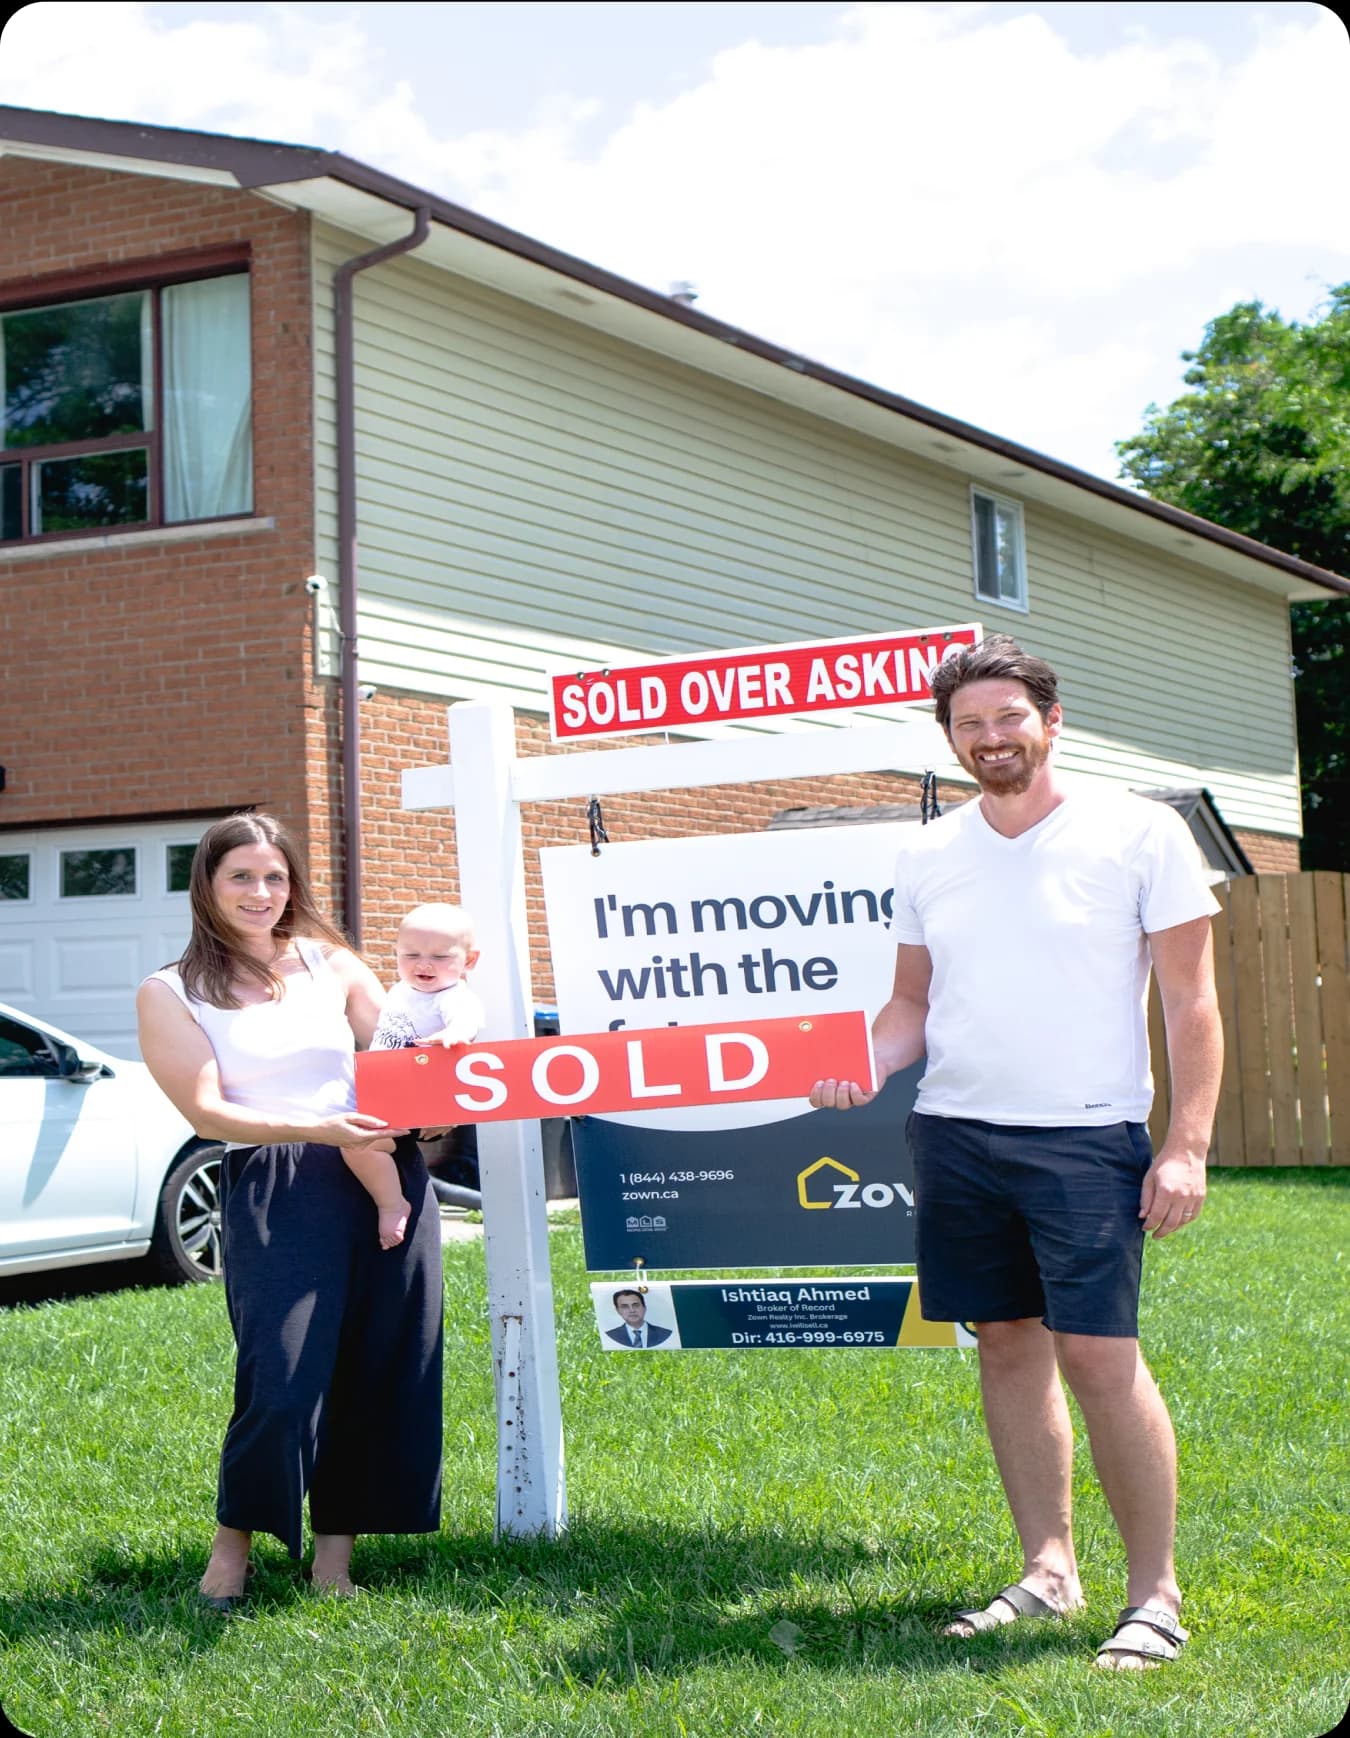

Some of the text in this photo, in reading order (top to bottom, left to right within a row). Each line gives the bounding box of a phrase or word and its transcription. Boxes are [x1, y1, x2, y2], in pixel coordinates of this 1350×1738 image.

[562, 677, 667, 728] SOLD
[680, 663, 794, 715] OVER
[594, 894, 678, 938] I'm
[597, 948, 838, 1000] with the
[454, 1032, 769, 1111] SOLD
[619, 1169, 735, 1186] 1 (844) 438-9696
[622, 1190, 680, 1201] zown.ca
[721, 1286, 871, 1304] Ishtiaq Ahmed
[756, 1304, 787, 1312] Broker
[801, 1303, 836, 1312] Record
[769, 1314, 793, 1322] Realty
[809, 1313, 849, 1322] Brokerage
[731, 1331, 885, 1344] Dir: 416-999-6975
